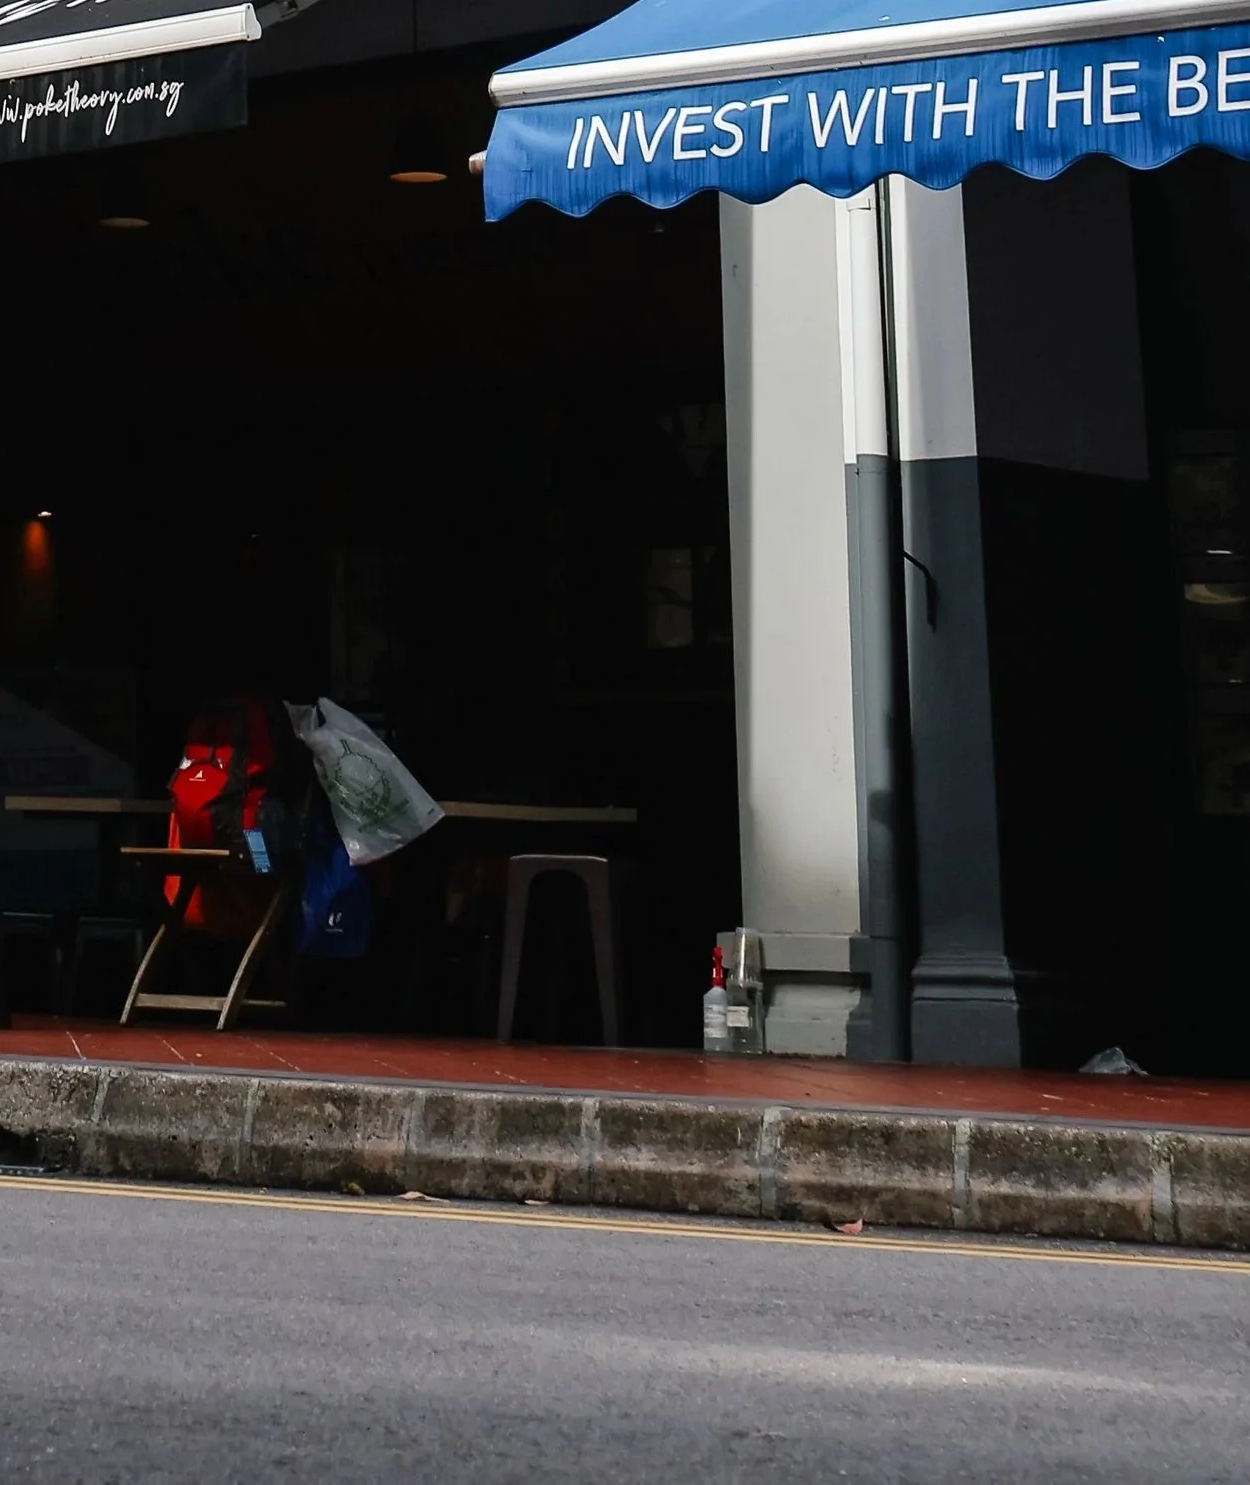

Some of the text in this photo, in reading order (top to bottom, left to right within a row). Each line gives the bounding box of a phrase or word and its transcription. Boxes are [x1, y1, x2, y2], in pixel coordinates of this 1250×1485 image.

[566, 93, 790, 170] INVEST
[807, 78, 976, 149] WITH
[1001, 61, 1142, 132] THE
